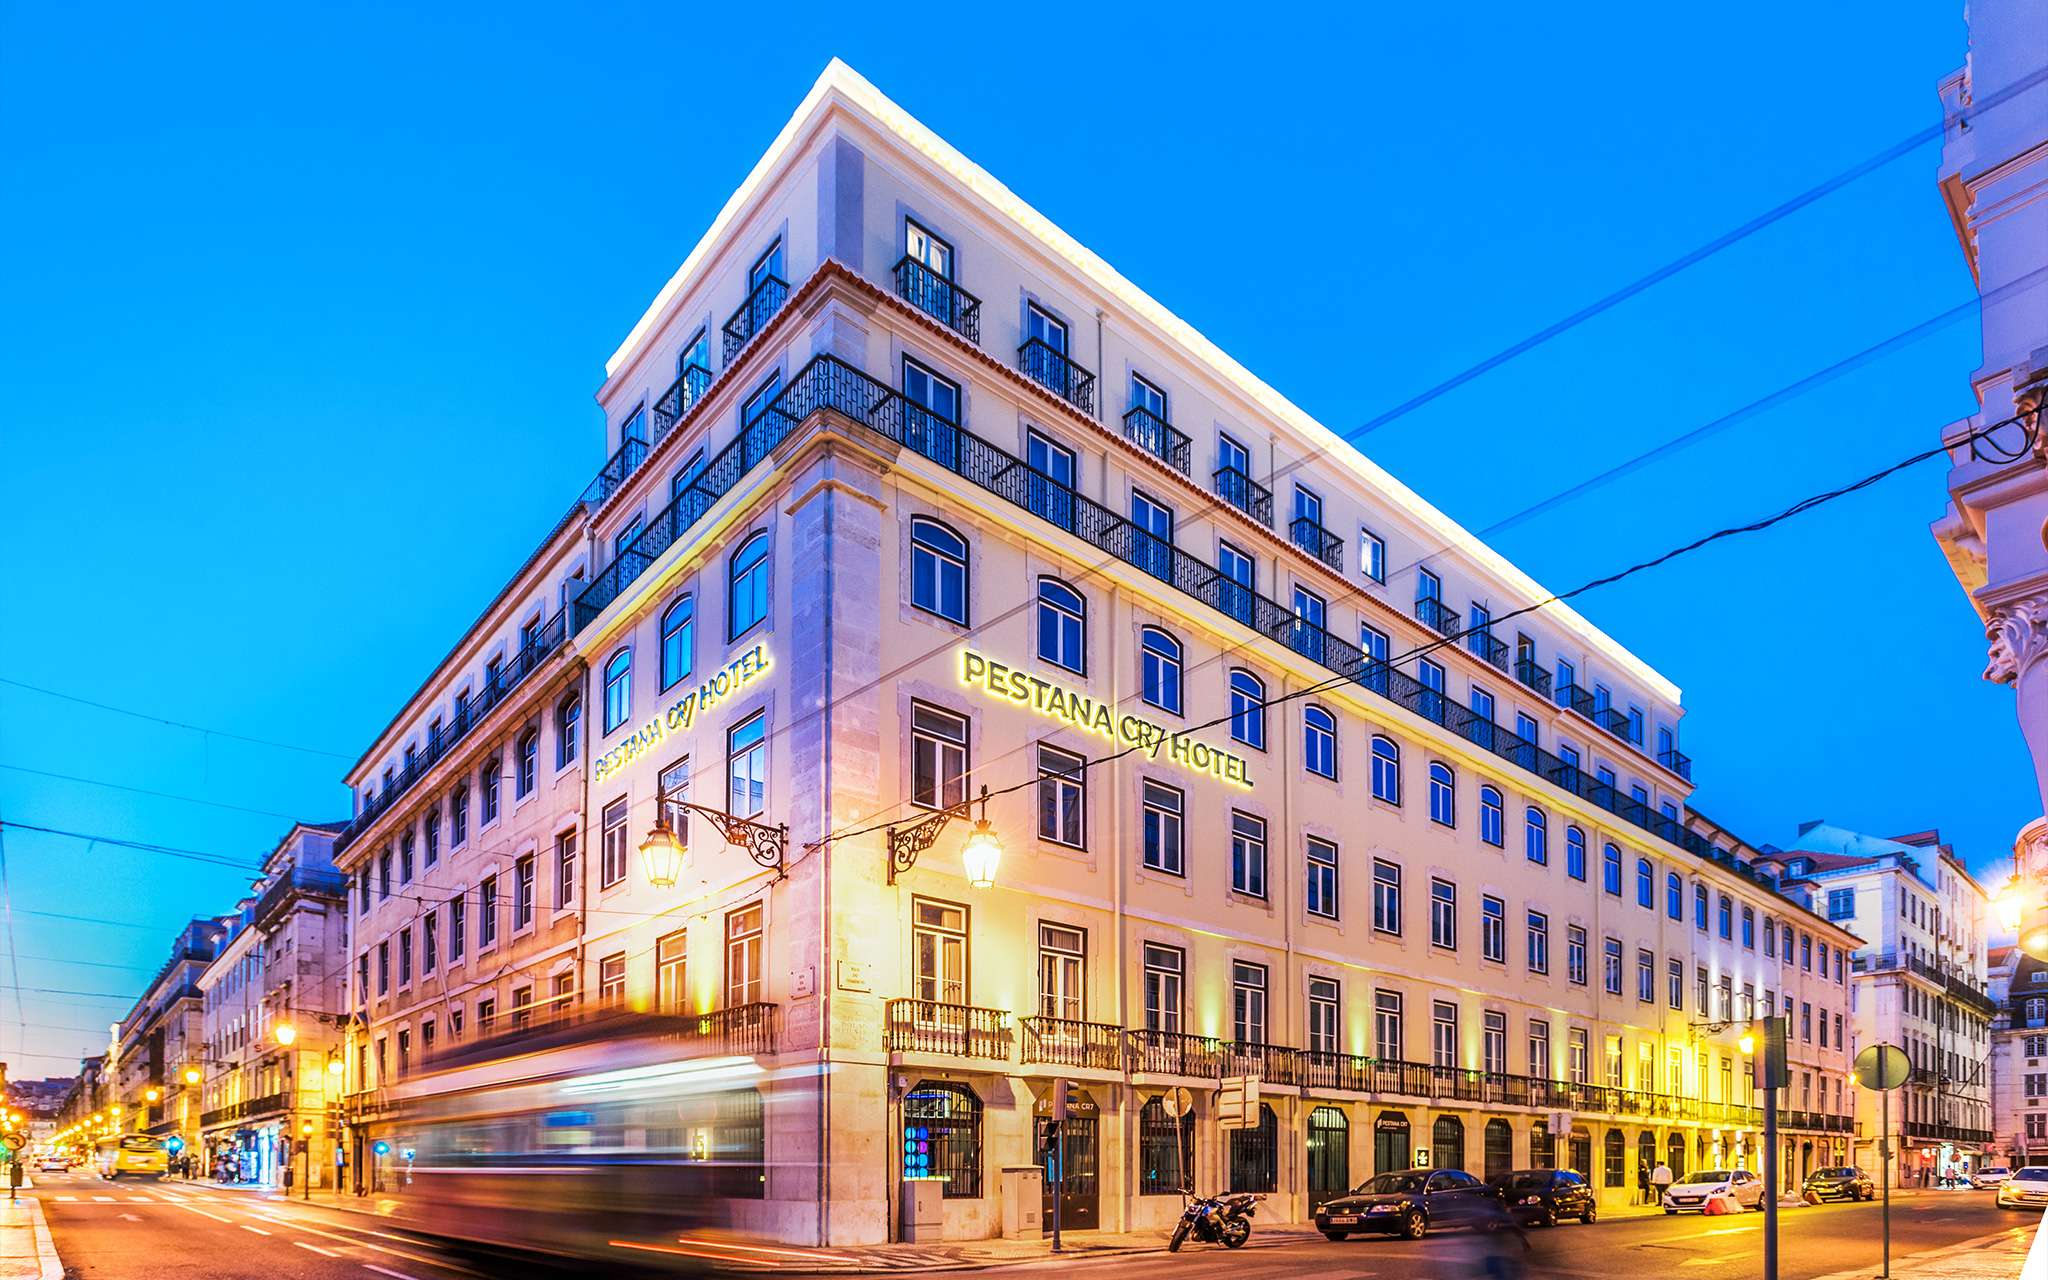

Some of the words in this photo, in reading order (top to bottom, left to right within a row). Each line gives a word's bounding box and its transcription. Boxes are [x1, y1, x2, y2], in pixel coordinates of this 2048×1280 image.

[595, 718, 663, 782] PESTANA
[667, 692, 697, 730] CR7
[700, 645, 769, 710] HOTEL
[963, 651, 1114, 735] PESTANA
[1121, 715, 1166, 758] CR7
[1170, 733, 1254, 787] HOTEL
[1081, 1102, 1094, 1110] CR7
